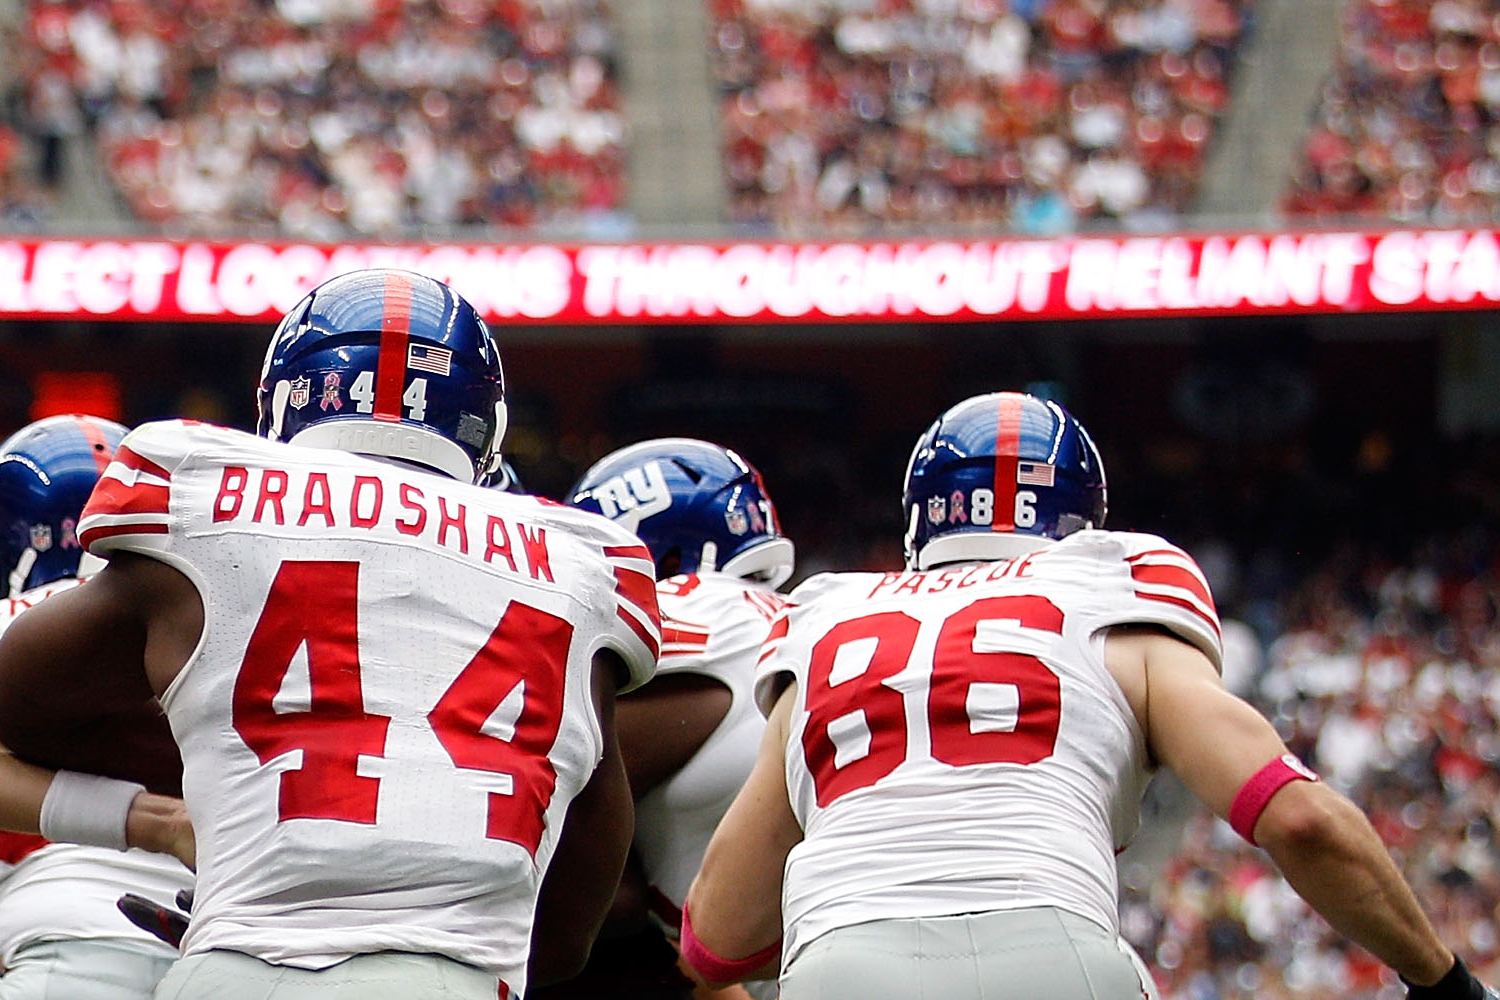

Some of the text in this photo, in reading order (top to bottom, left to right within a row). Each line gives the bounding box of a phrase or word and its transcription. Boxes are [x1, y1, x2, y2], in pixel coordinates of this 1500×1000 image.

[577, 243, 1070, 317] THROUGHOUT
[1065, 235, 1371, 311] RELIANT
[213, 466, 556, 583] BRADSHAW
[232, 560, 575, 868] 44
[801, 594, 1065, 809] 86
